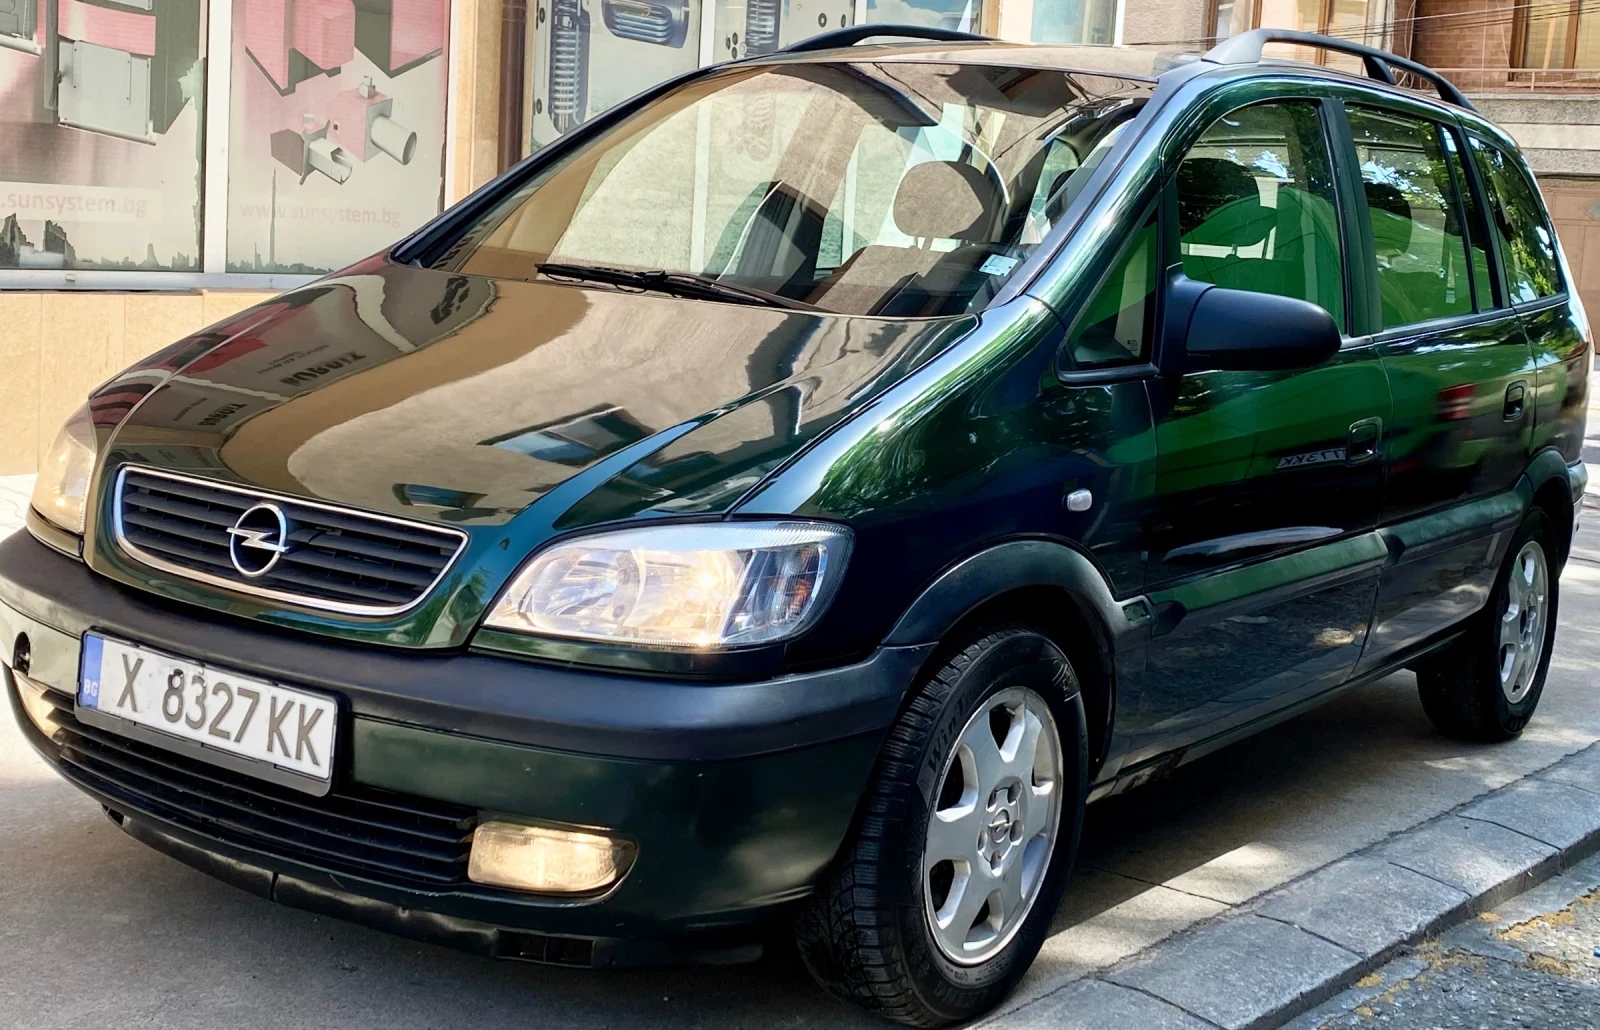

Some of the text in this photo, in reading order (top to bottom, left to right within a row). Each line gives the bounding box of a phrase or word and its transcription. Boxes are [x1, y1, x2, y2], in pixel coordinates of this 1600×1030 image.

[83, 678, 99, 696] BG
[117, 653, 325, 767] X 8327 KK
